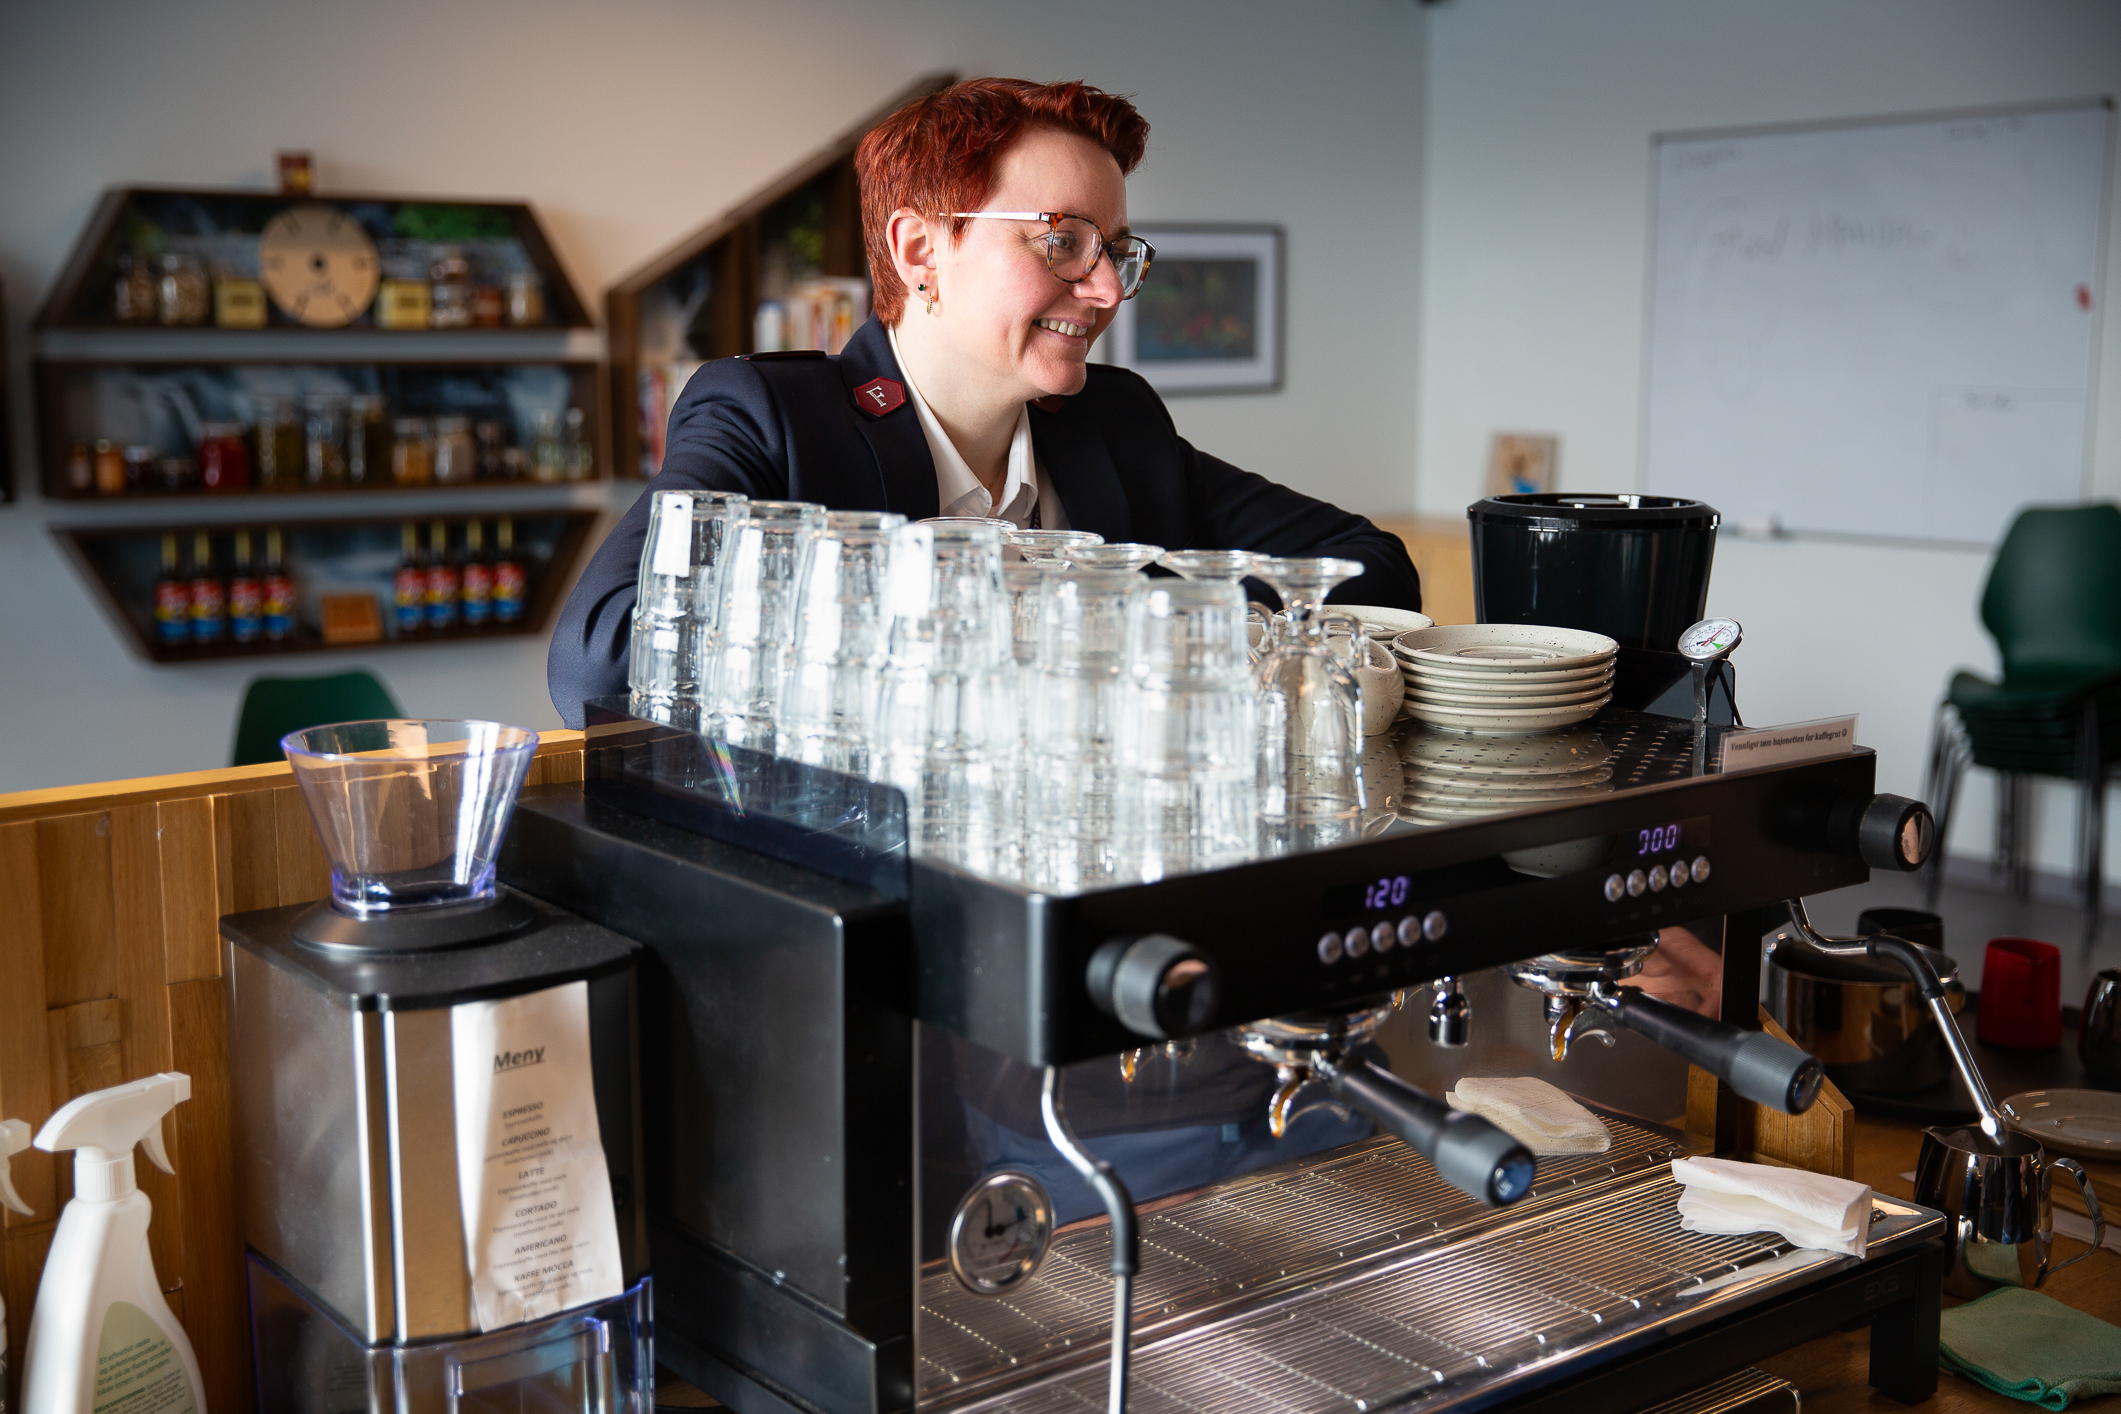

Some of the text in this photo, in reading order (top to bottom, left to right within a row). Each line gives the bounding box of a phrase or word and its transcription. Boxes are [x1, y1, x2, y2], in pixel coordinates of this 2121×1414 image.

[1731, 741, 1759, 751] Vennligst
[1773, 735, 1804, 747] bajonetten
[1805, 733, 1814, 742] for
[1815, 730, 1841, 741] kaffegrut
[1365, 876, 1408, 908] 120
[493, 1046, 546, 1072] Meny
[502, 1101, 544, 1119] ESPRESSO
[501, 1127, 550, 1147] CAPUCCINO
[518, 1167, 545, 1180] LATTE
[515, 1200, 557, 1218] CORTADO
[514, 1234, 567, 1255] AMERICANO
[514, 1260, 574, 1283] KAFFE MOCCA
